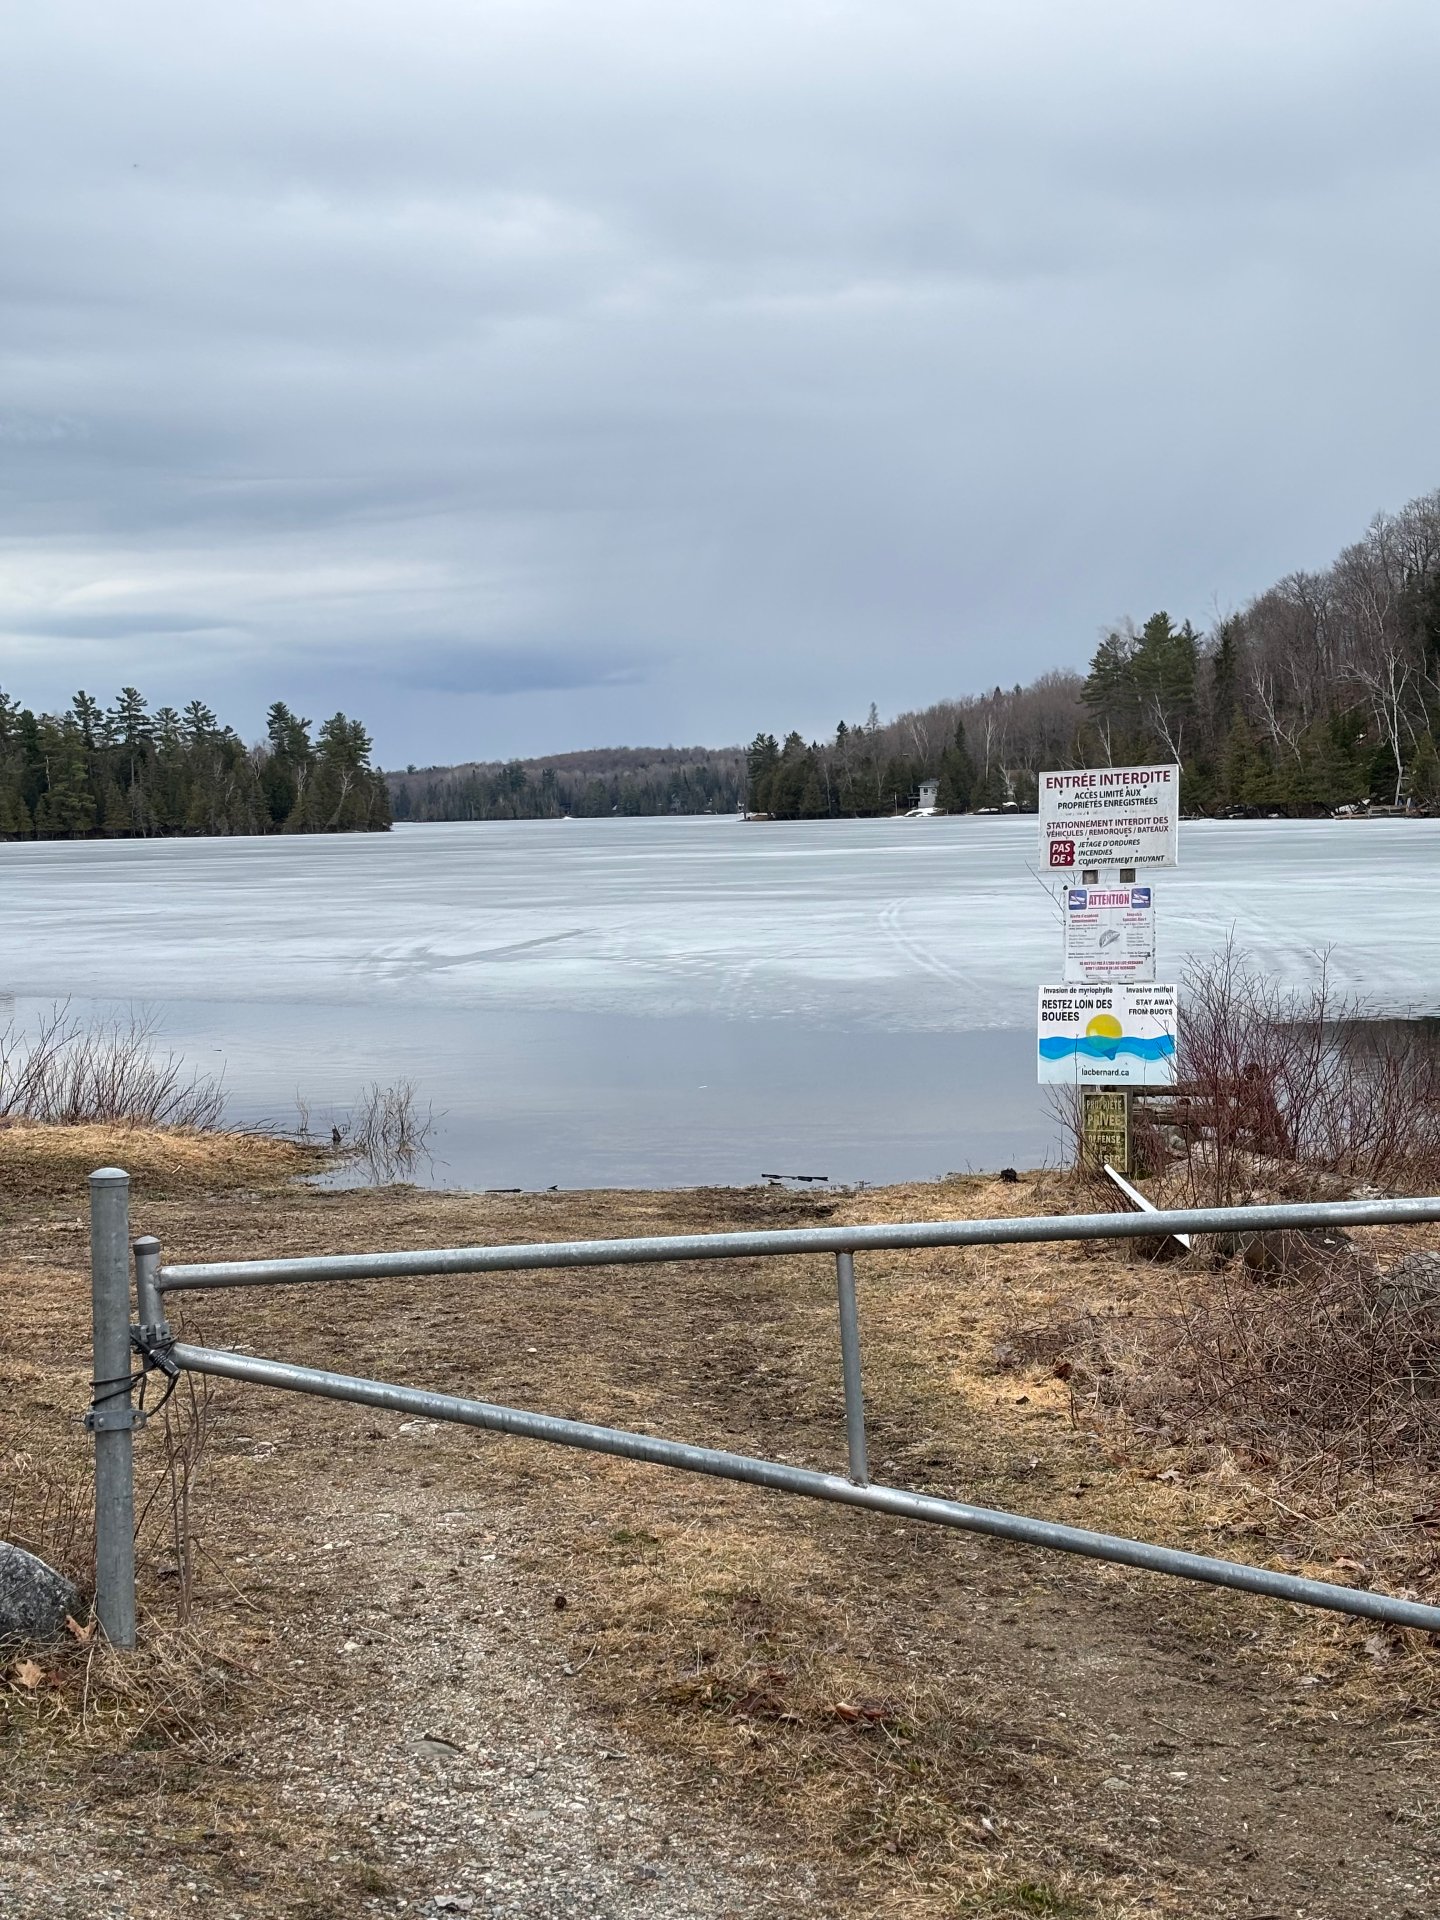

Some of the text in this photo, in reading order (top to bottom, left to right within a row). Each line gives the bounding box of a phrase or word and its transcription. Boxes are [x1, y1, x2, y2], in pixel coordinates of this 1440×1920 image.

[1046, 770, 1171, 789] ENTRÉE INTERDITE
[1074, 787, 1142, 800] ACCÈS LIMITÉ AUX
[1057, 797, 1158, 810] PROPRIÉTÉS ENREGISTRÉES
[1046, 816, 1169, 830] STATIONNEMENT INTERDIT DES
[1046, 829, 1084, 838] VÉHICULES
[1088, 826, 1132, 836] REMORQUES
[1137, 825, 1169, 834] BATEAUX
[1051, 843, 1071, 853] PAS
[1077, 838, 1141, 849] JETAGE D'ORDURES
[1077, 848, 1113, 857] INCENDIES
[1051, 855, 1066, 864] DE
[1077, 854, 1166, 866] COMPORTEMENT BRUYANT
[1088, 893, 1130, 906] ATTENTION
[1043, 986, 1114, 996] Invasion de myriophylle
[1126, 985, 1174, 994] Invasive milfoil
[1041, 999, 1113, 1010] RESTEZ LOIN DES
[1135, 998, 1153, 1007] STAY
[1128, 1008, 1173, 1016] FROM BUOYS
[1081, 1068, 1130, 1077] lacbernard.ca
